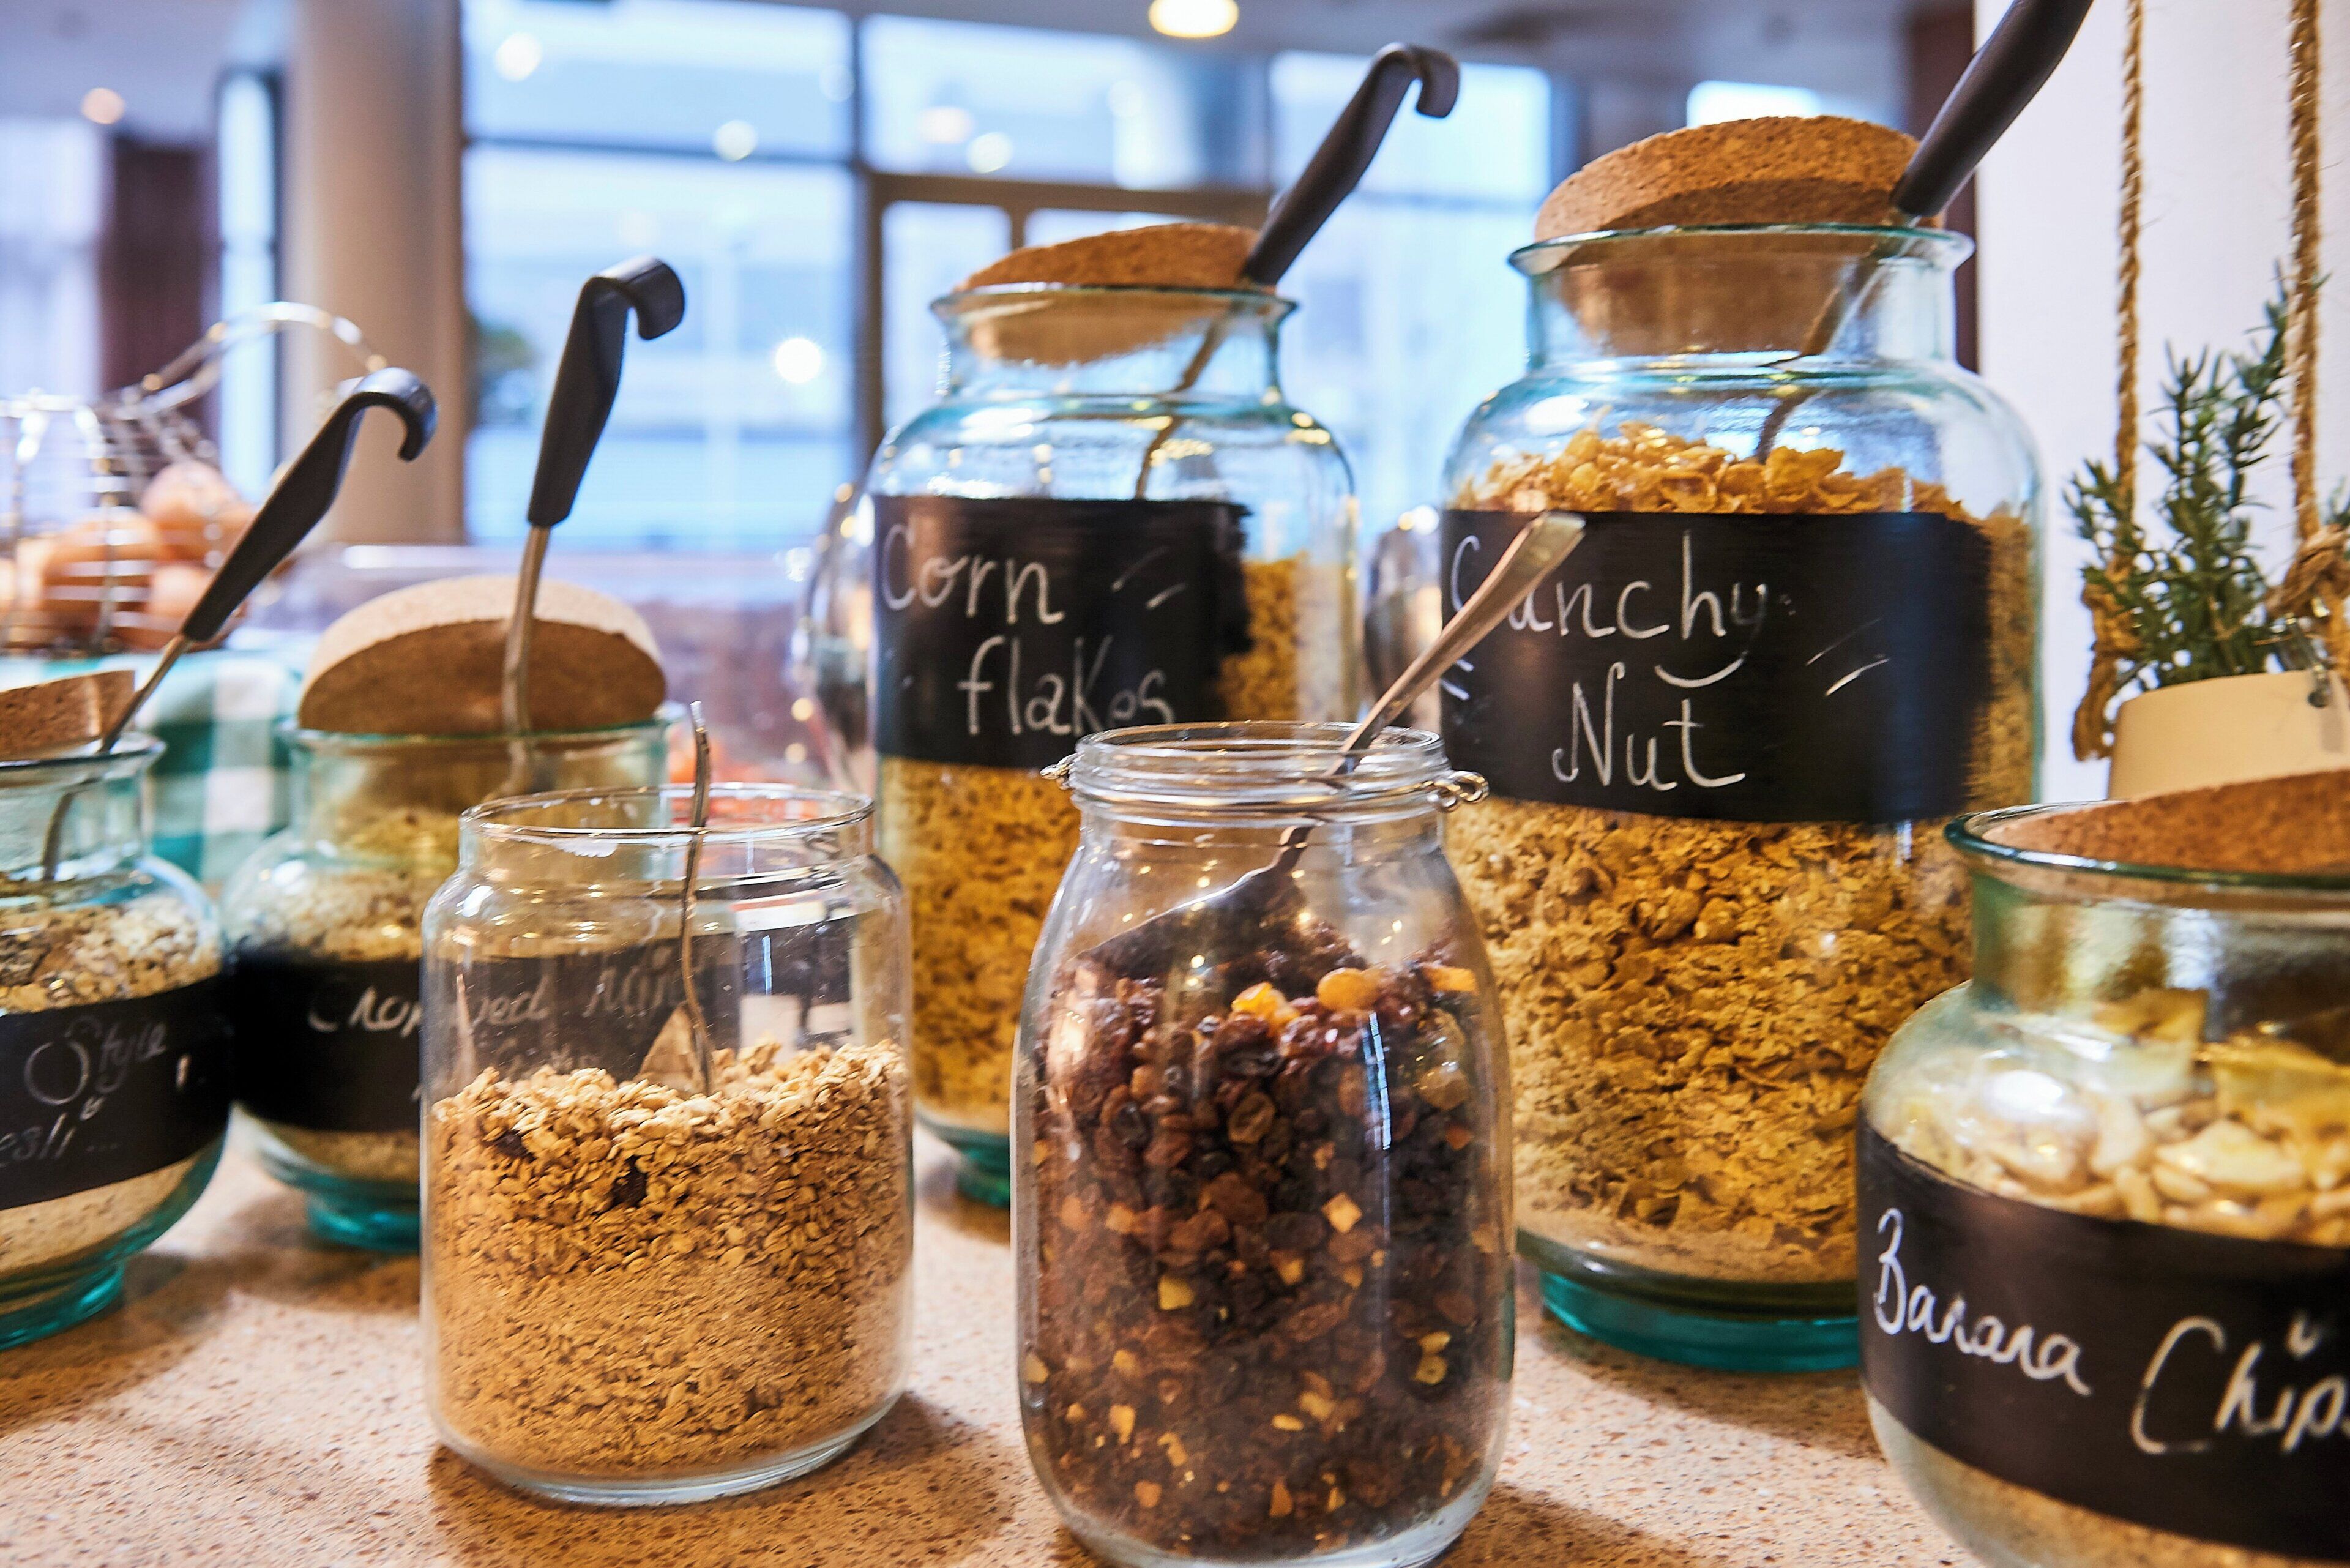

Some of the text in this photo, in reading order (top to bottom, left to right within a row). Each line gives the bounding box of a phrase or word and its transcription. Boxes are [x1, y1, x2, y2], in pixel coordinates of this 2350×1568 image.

[882, 523, 1065, 625] Corn
[1450, 529, 1767, 688] Cunchy
[1551, 662, 1746, 791] Nut
[1873, 1207, 2350, 1454] Banana Chip
